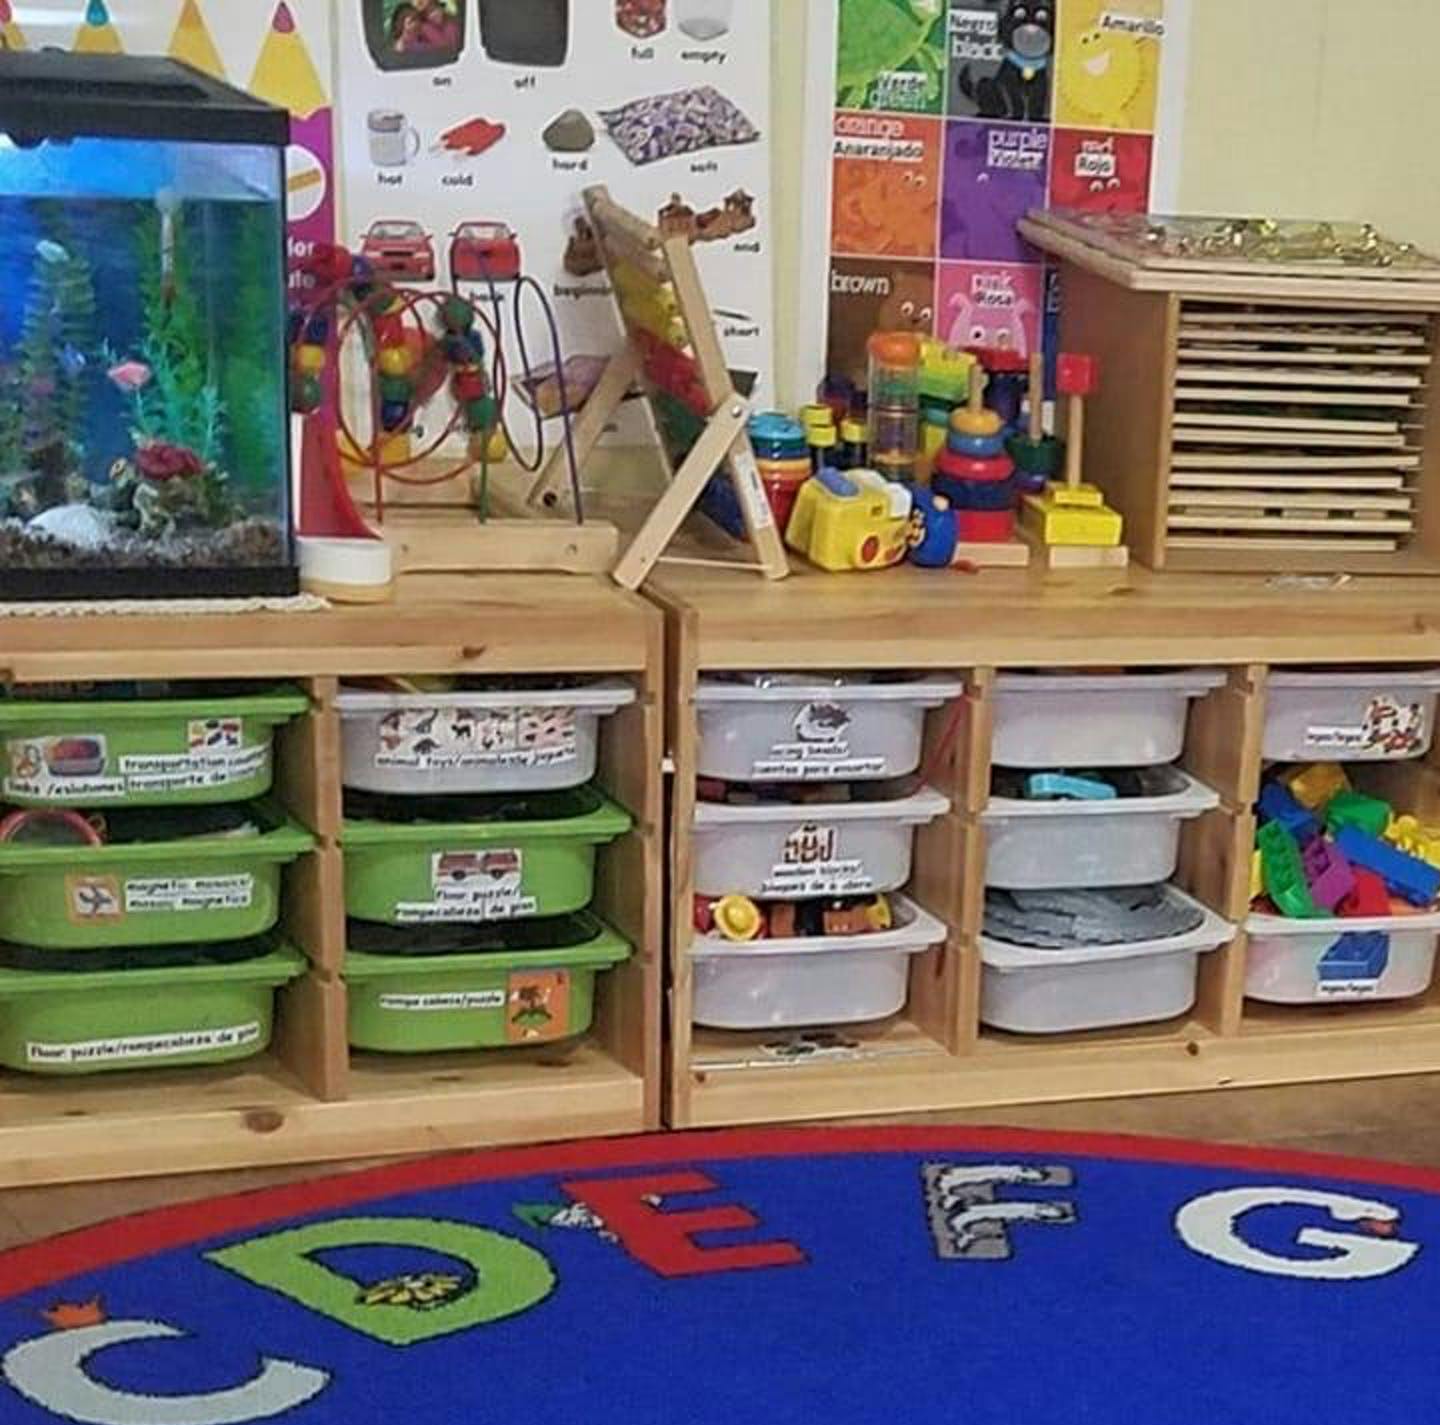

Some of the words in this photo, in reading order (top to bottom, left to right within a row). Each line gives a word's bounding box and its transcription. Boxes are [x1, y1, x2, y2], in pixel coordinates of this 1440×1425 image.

[1101, 15, 1164, 36] Amarillo
[630, 48, 654, 60] full
[680, 49, 728, 65] empty
[433, 76, 452, 87] on
[513, 76, 537, 89] off
[988, 124, 1048, 152] purple
[1081, 137, 1114, 154] red
[552, 158, 588, 172] hard
[690, 161, 719, 174] soft
[1078, 156, 1112, 174] Rojo
[377, 173, 403, 186] hot
[442, 172, 474, 187] cold
[831, 270, 890, 297] brown
[723, 326, 760, 337] short
[203, 1215, 558, 1345] D
[558, 1172, 806, 1277] E
[920, 1160, 1077, 1260] F
[1174, 1185, 1422, 1280] G
